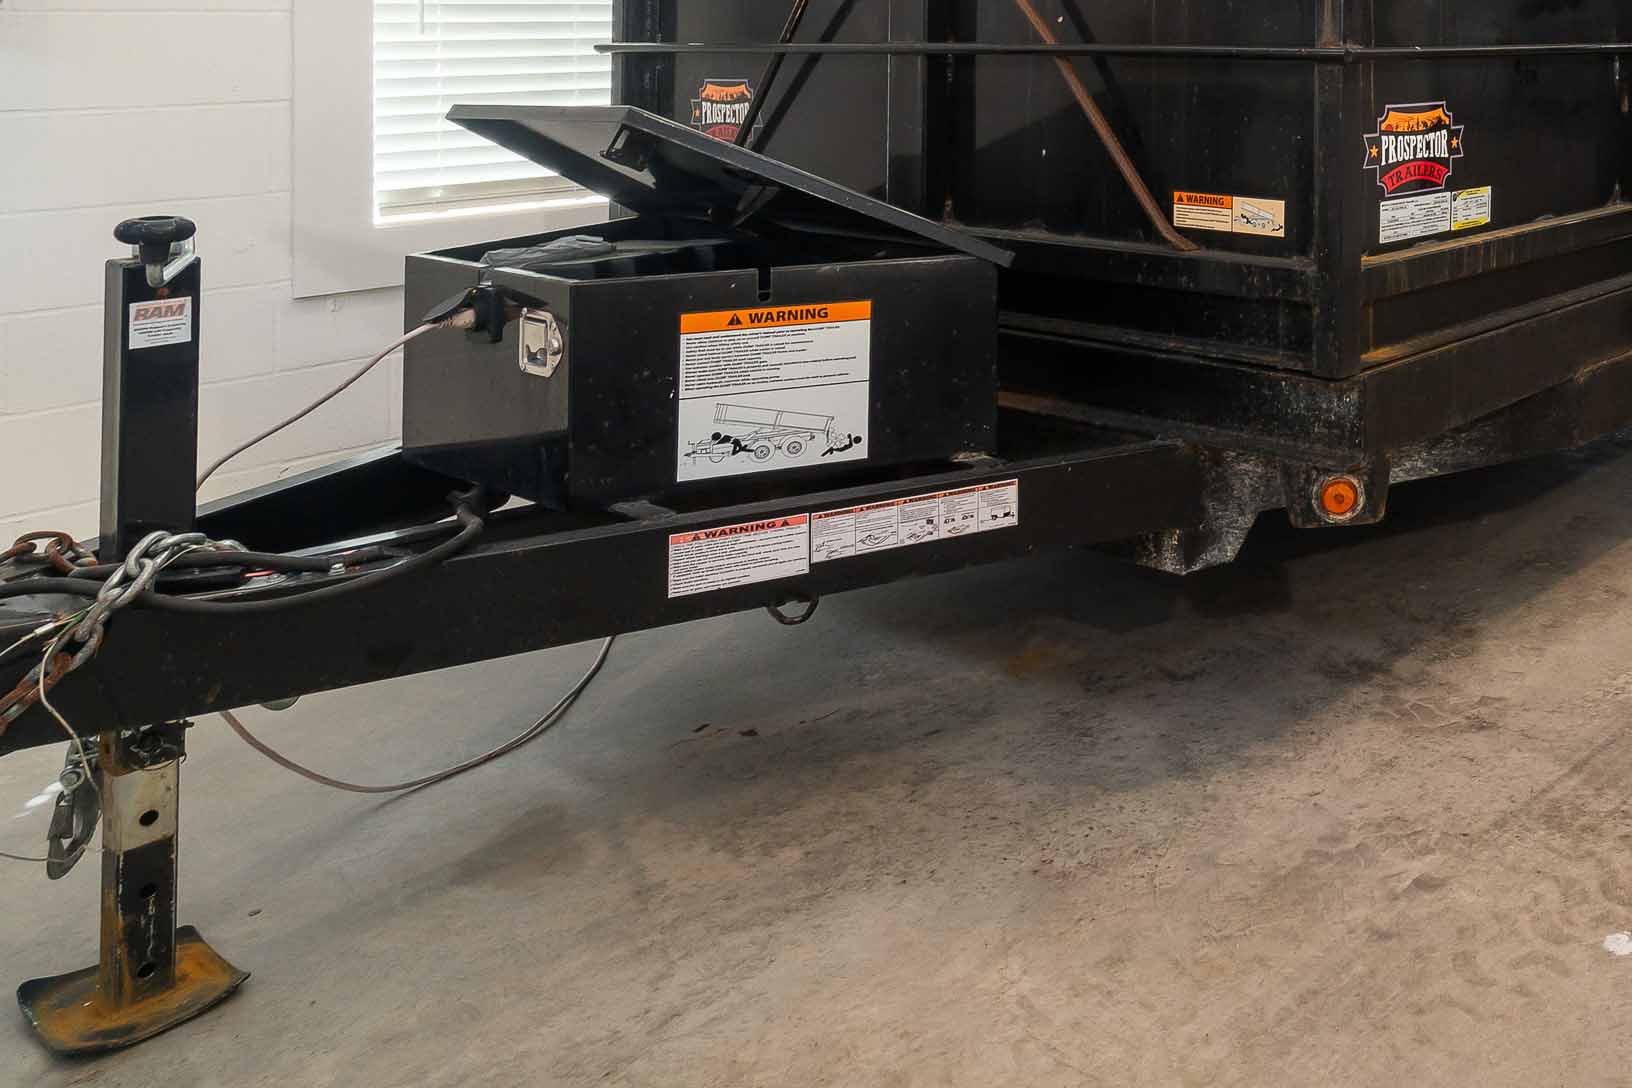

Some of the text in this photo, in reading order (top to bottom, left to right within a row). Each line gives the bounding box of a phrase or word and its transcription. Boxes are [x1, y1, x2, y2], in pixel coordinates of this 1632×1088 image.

[1381, 129, 1449, 166] PROSPECTOR
[1388, 164, 1443, 187] TRAILERS
[1185, 193, 1225, 206] WARNING
[749, 307, 829, 324] WARNING
[704, 521, 777, 538] WARNING
